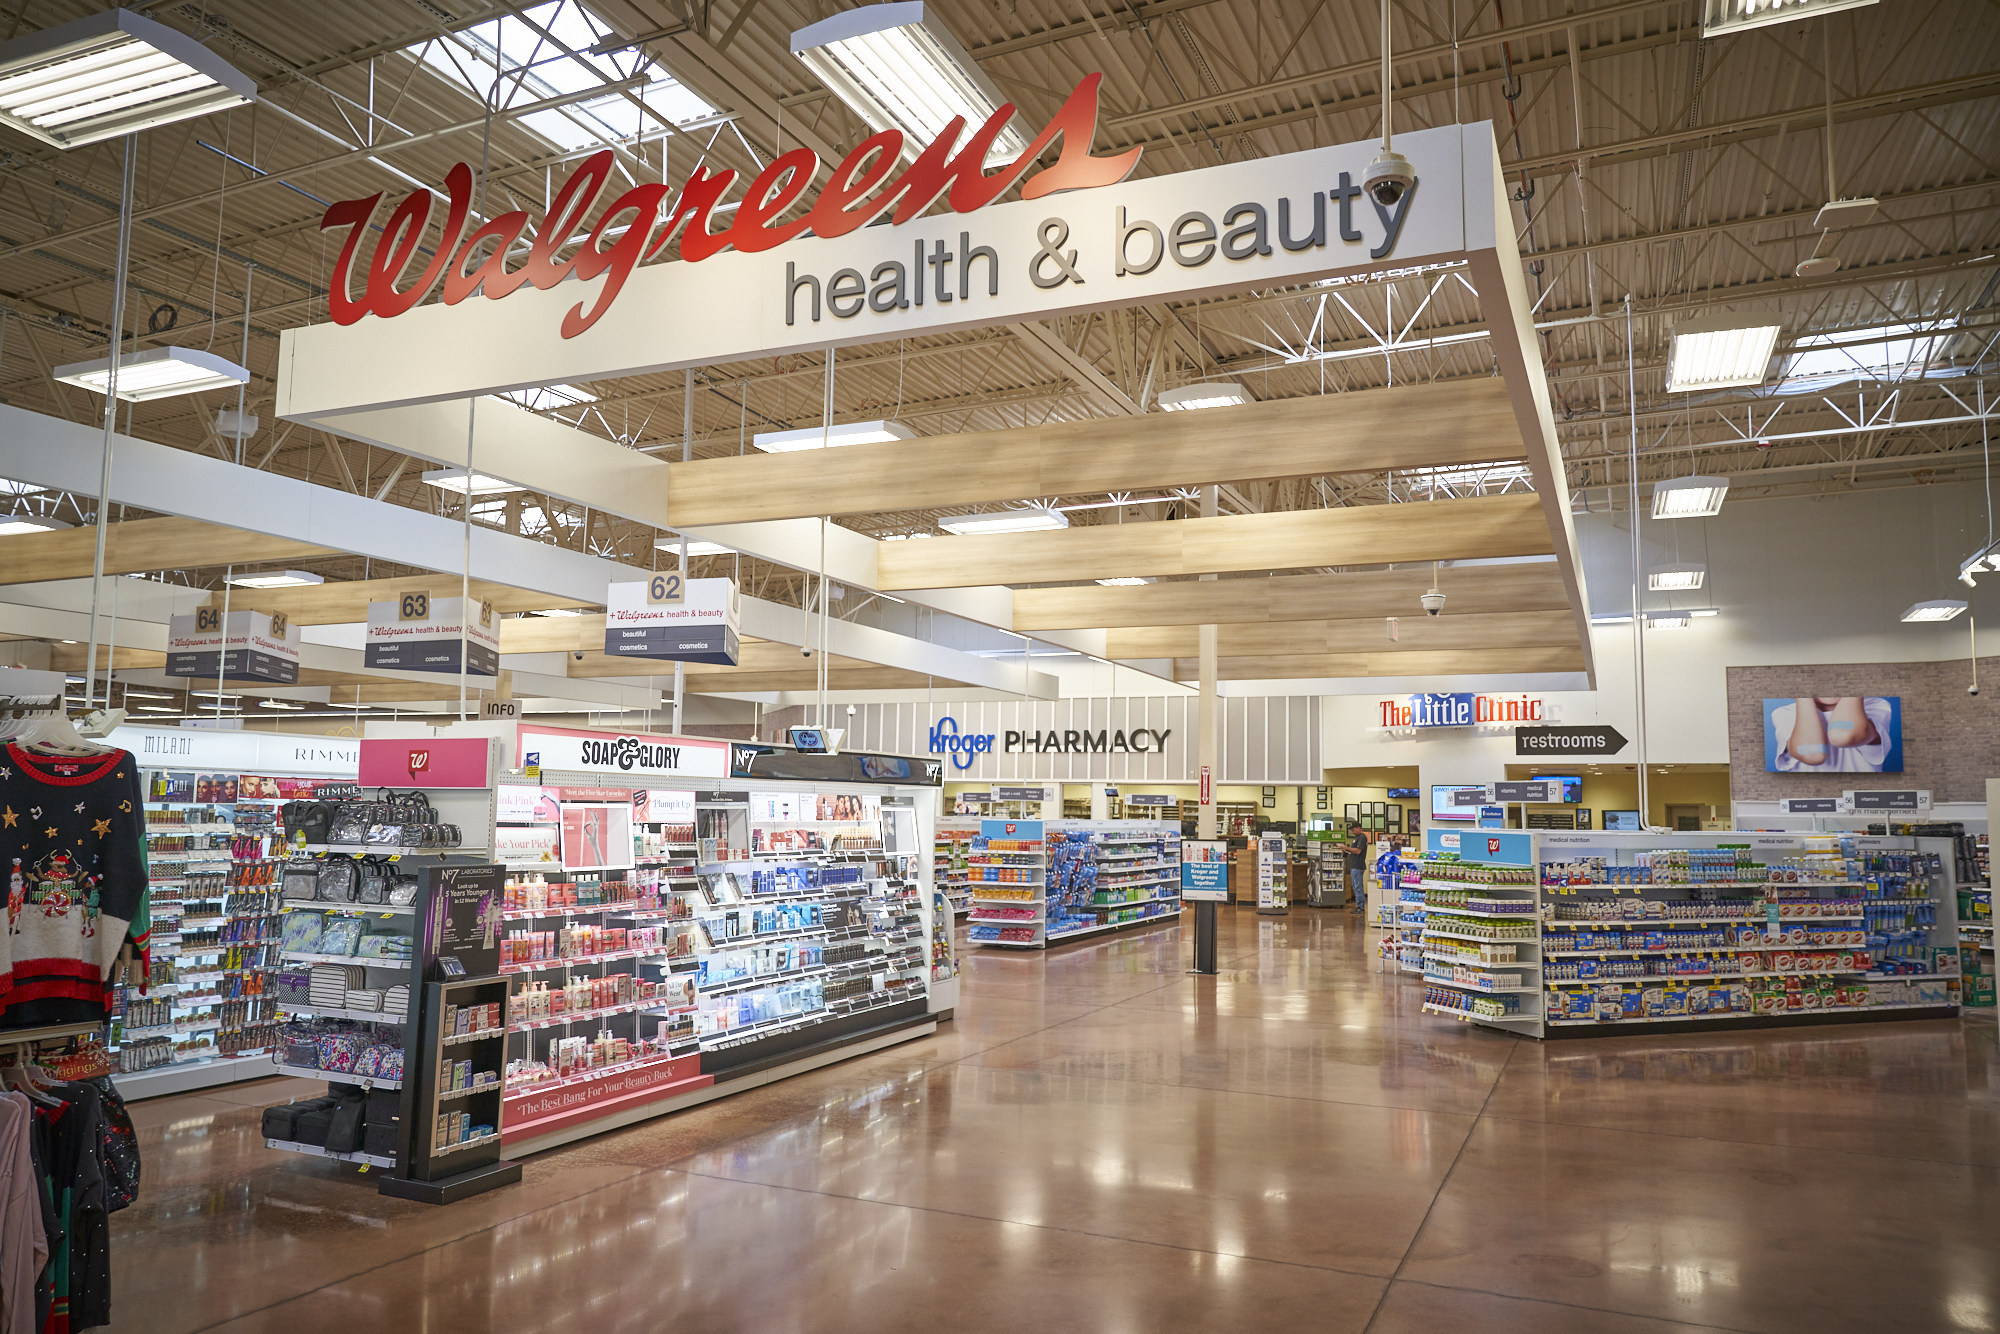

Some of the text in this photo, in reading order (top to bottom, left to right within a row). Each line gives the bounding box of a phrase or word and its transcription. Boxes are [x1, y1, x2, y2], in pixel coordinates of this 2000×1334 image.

[320, 72, 1143, 340] Walgreens
[785, 170, 1419, 326] health & beauty
[651, 575, 680, 600] 62
[402, 594, 427, 617] 63
[482, 600, 491, 624] 63
[199, 609, 218, 630] 64
[617, 609, 724, 622] Walgreens health & beauty
[273, 614, 285, 636] 64
[375, 626, 413, 638] Walgreens
[441, 625, 463, 633] beauty
[622, 630, 646, 638] beautiful
[175, 638, 207, 649] Walgreens
[209, 637, 222, 645] healt
[230, 637, 248, 645] beauty
[619, 643, 648, 651] cosmetics
[679, 642, 708, 650] cosmetics
[425, 655, 449, 663] cosmetics
[487, 703, 514, 716] INFO
[1380, 694, 1541, 727] The Little Clinic
[144, 736, 191, 754] MILANI
[930, 717, 1171, 769] Kroger PHARMACY
[1522, 733, 1606, 748] restrooms
[410, 752, 427, 769] W
[581, 740, 618, 765] SOAP
[640, 745, 680, 769] GLORY
[1549, 787, 1556, 795] 57
[509, 839, 530, 849] Your
[445, 889, 489, 898] 5 Years Younger
[58, 1062, 97, 1077] ggings
[517, 1066, 675, 1116] 'The Best Bang For Your Beauty Buck'
